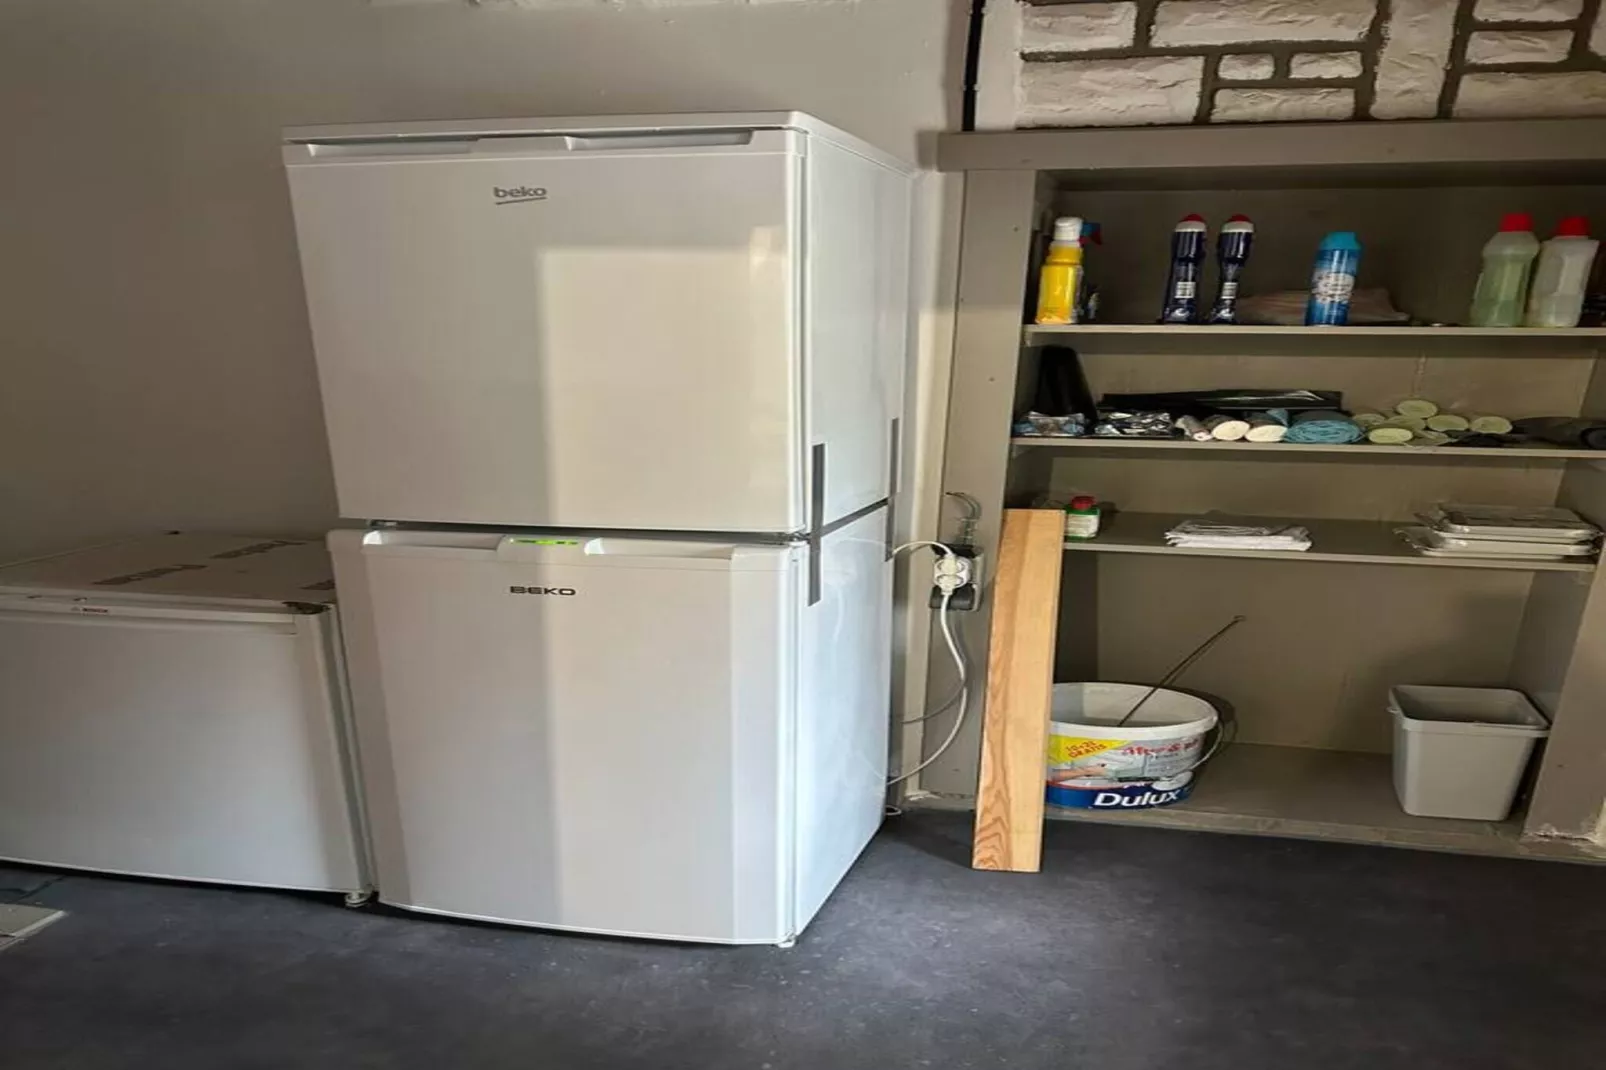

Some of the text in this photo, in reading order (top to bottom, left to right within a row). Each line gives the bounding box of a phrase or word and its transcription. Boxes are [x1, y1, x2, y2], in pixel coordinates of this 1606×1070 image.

[493, 186, 547, 200] beko
[510, 586, 576, 596] BEKO
[1094, 789, 1180, 807] Dulux
